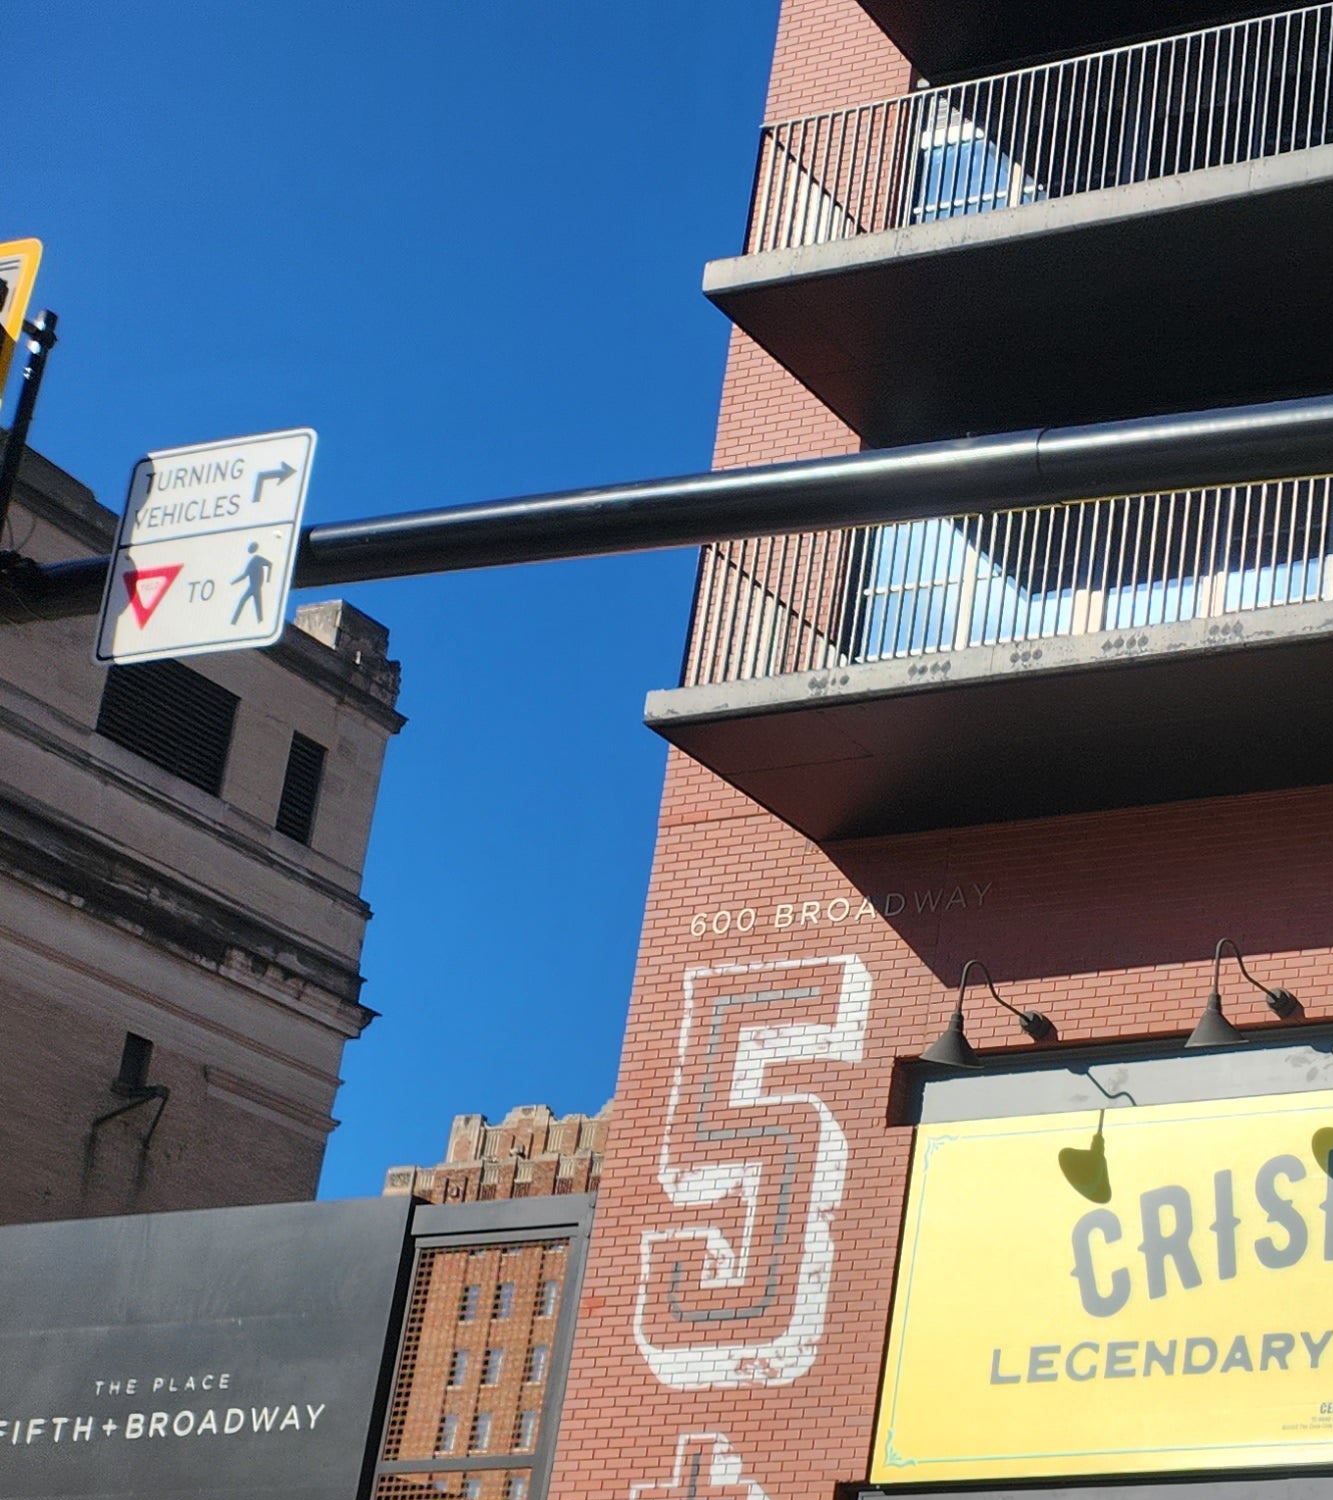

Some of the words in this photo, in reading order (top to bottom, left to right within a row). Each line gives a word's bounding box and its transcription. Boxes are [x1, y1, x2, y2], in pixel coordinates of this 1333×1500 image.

[145, 458, 245, 495] TURNING
[135, 494, 241, 530] VEHICLES
[188, 579, 215, 603] TO
[690, 907, 756, 938] 600
[774, 881, 993, 929] BROADWAY
[95, 1379, 138, 1396] THE
[153, 1373, 231, 1394] PLACE
